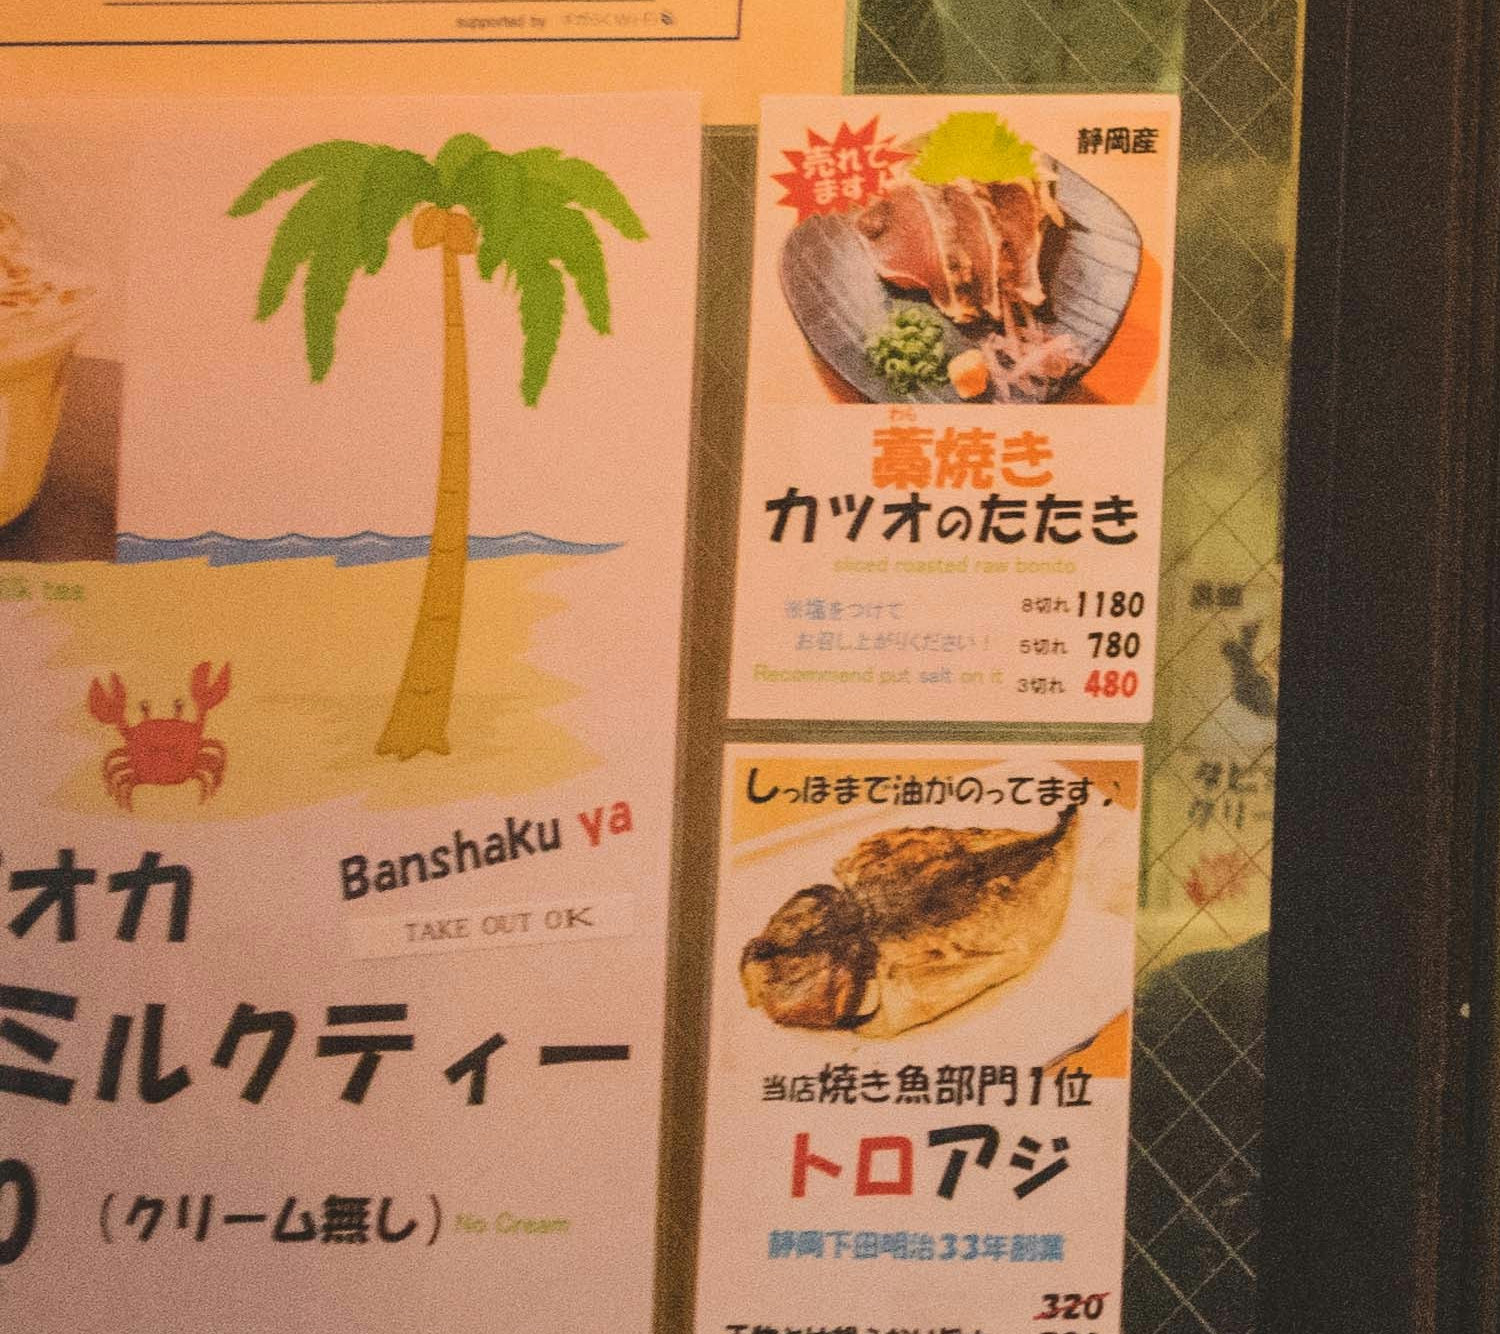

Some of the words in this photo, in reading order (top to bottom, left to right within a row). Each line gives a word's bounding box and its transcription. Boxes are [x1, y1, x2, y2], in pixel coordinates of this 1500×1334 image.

[763, 487, 1140, 545] カツオのたたき
[1076, 590, 1146, 619] 1180
[1087, 632, 1142, 660] 780
[1084, 669, 1140, 699] 480
[789, 1123, 1071, 1200] トロアジ
[1040, 1292, 1105, 1321] 320
